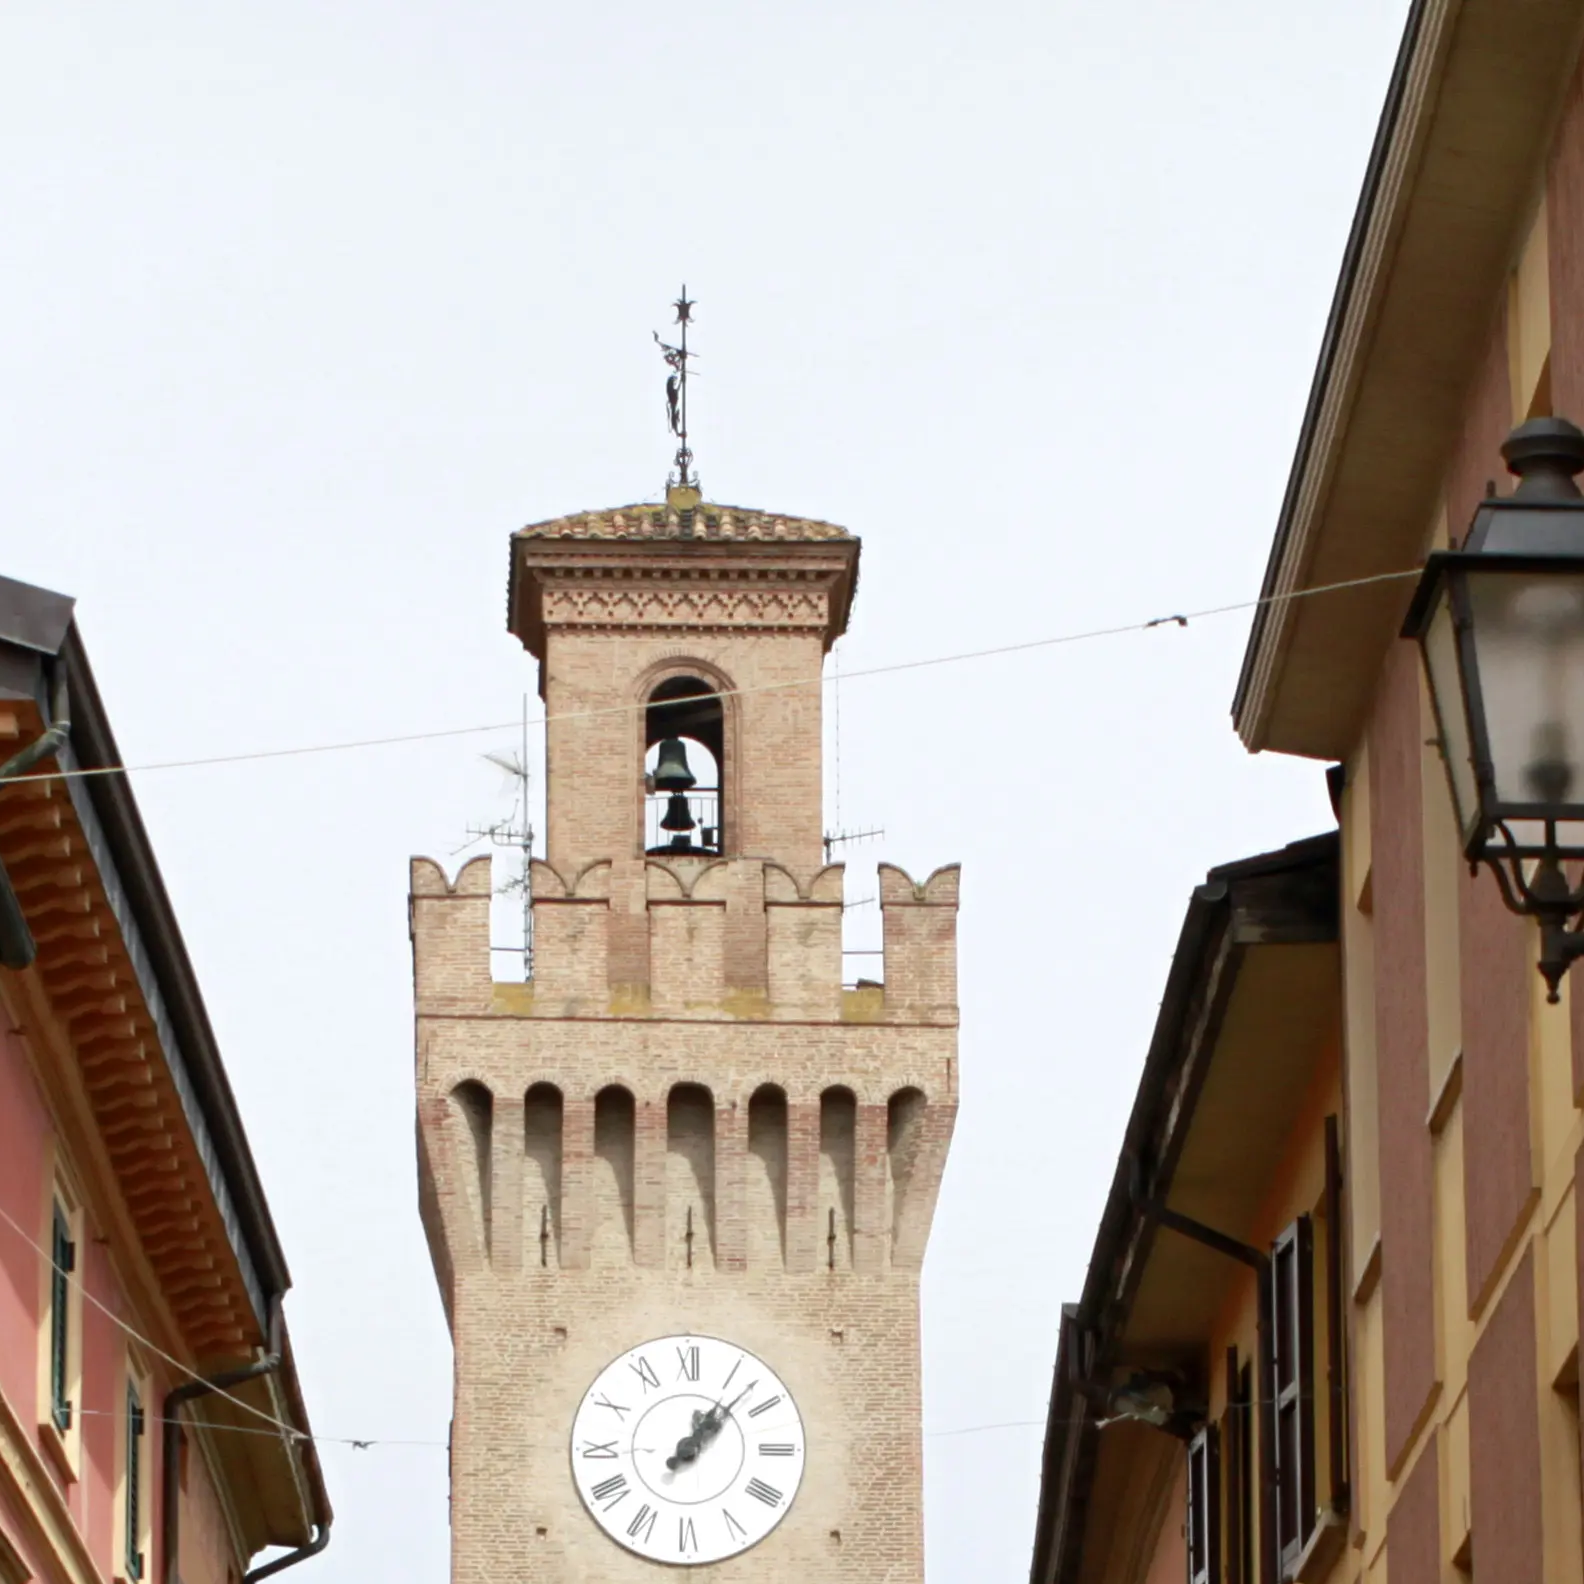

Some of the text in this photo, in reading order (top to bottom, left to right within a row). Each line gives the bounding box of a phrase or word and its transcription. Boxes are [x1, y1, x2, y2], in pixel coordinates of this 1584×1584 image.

[628, 1356, 661, 1394] XI
[676, 1346, 700, 1382] XII
[594, 1392, 631, 1422] X
[748, 1395, 781, 1418] II
[583, 1440, 619, 1458] IX
[758, 1443, 795, 1456] III
[591, 1473, 631, 1512] VIII
[626, 1504, 658, 1544] VII
[679, 1517, 698, 1552] VI
[722, 1508, 747, 1542] V
